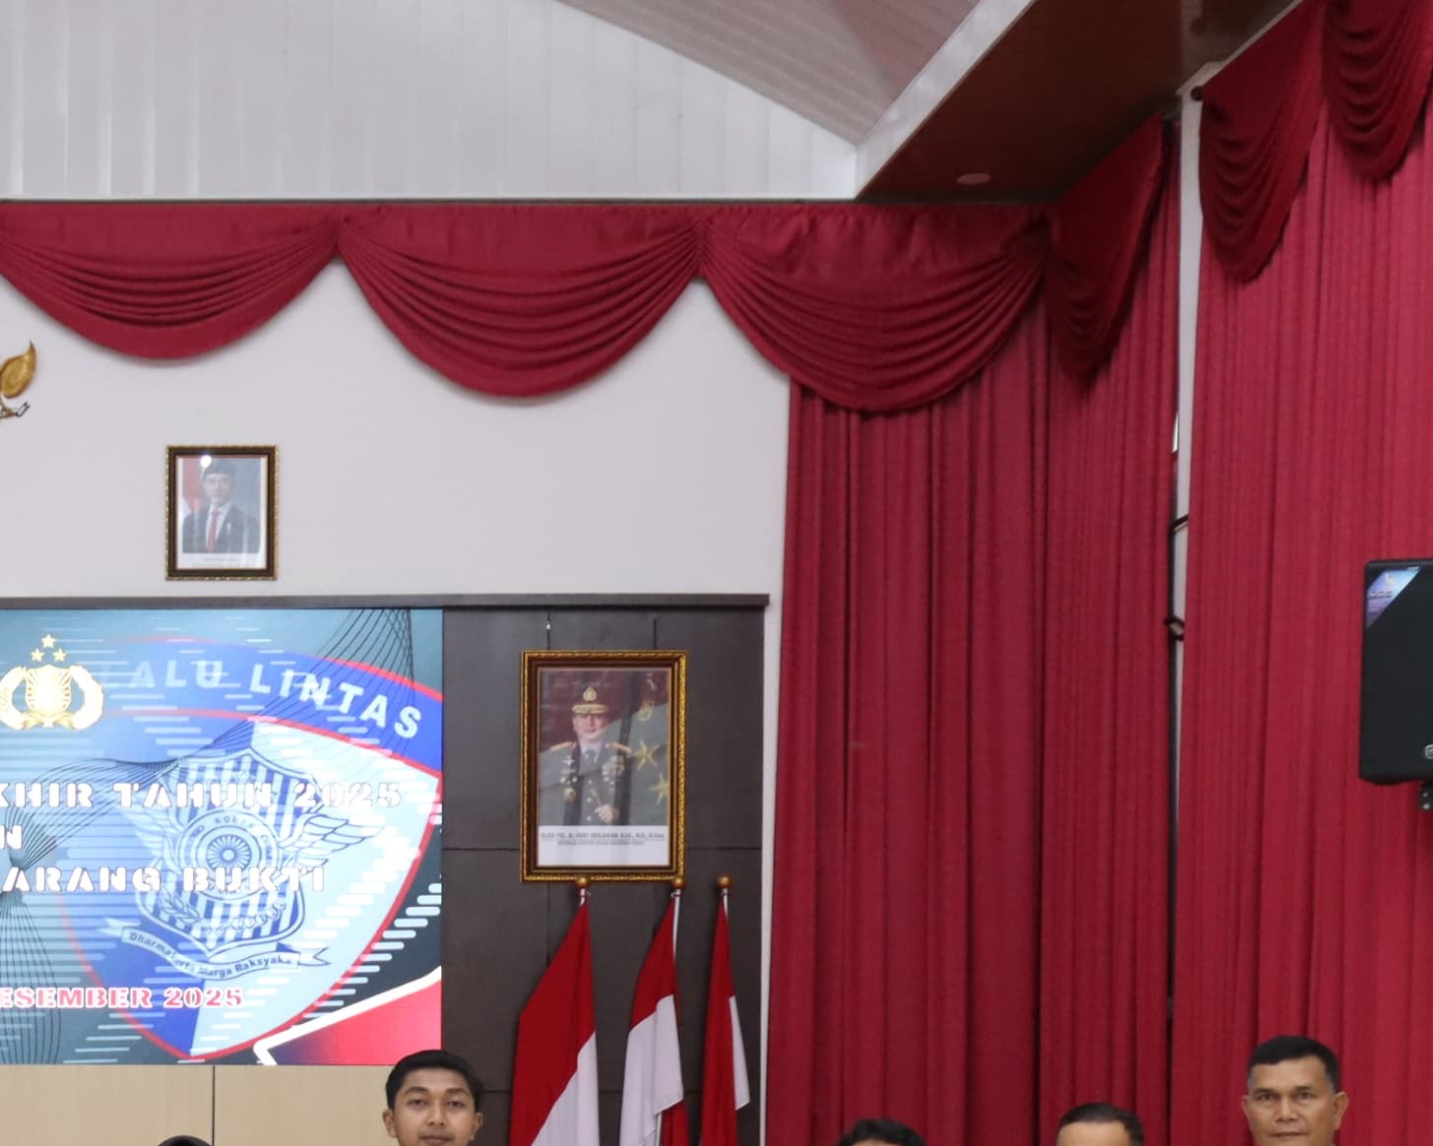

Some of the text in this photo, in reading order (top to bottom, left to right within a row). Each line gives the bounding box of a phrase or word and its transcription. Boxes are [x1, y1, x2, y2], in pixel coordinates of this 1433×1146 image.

[249, 663, 422, 740] LINTAS
[112, 781, 274, 809] TAHUN
[182, 865, 326, 893] BUKTI
[162, 985, 244, 1009] 2025
